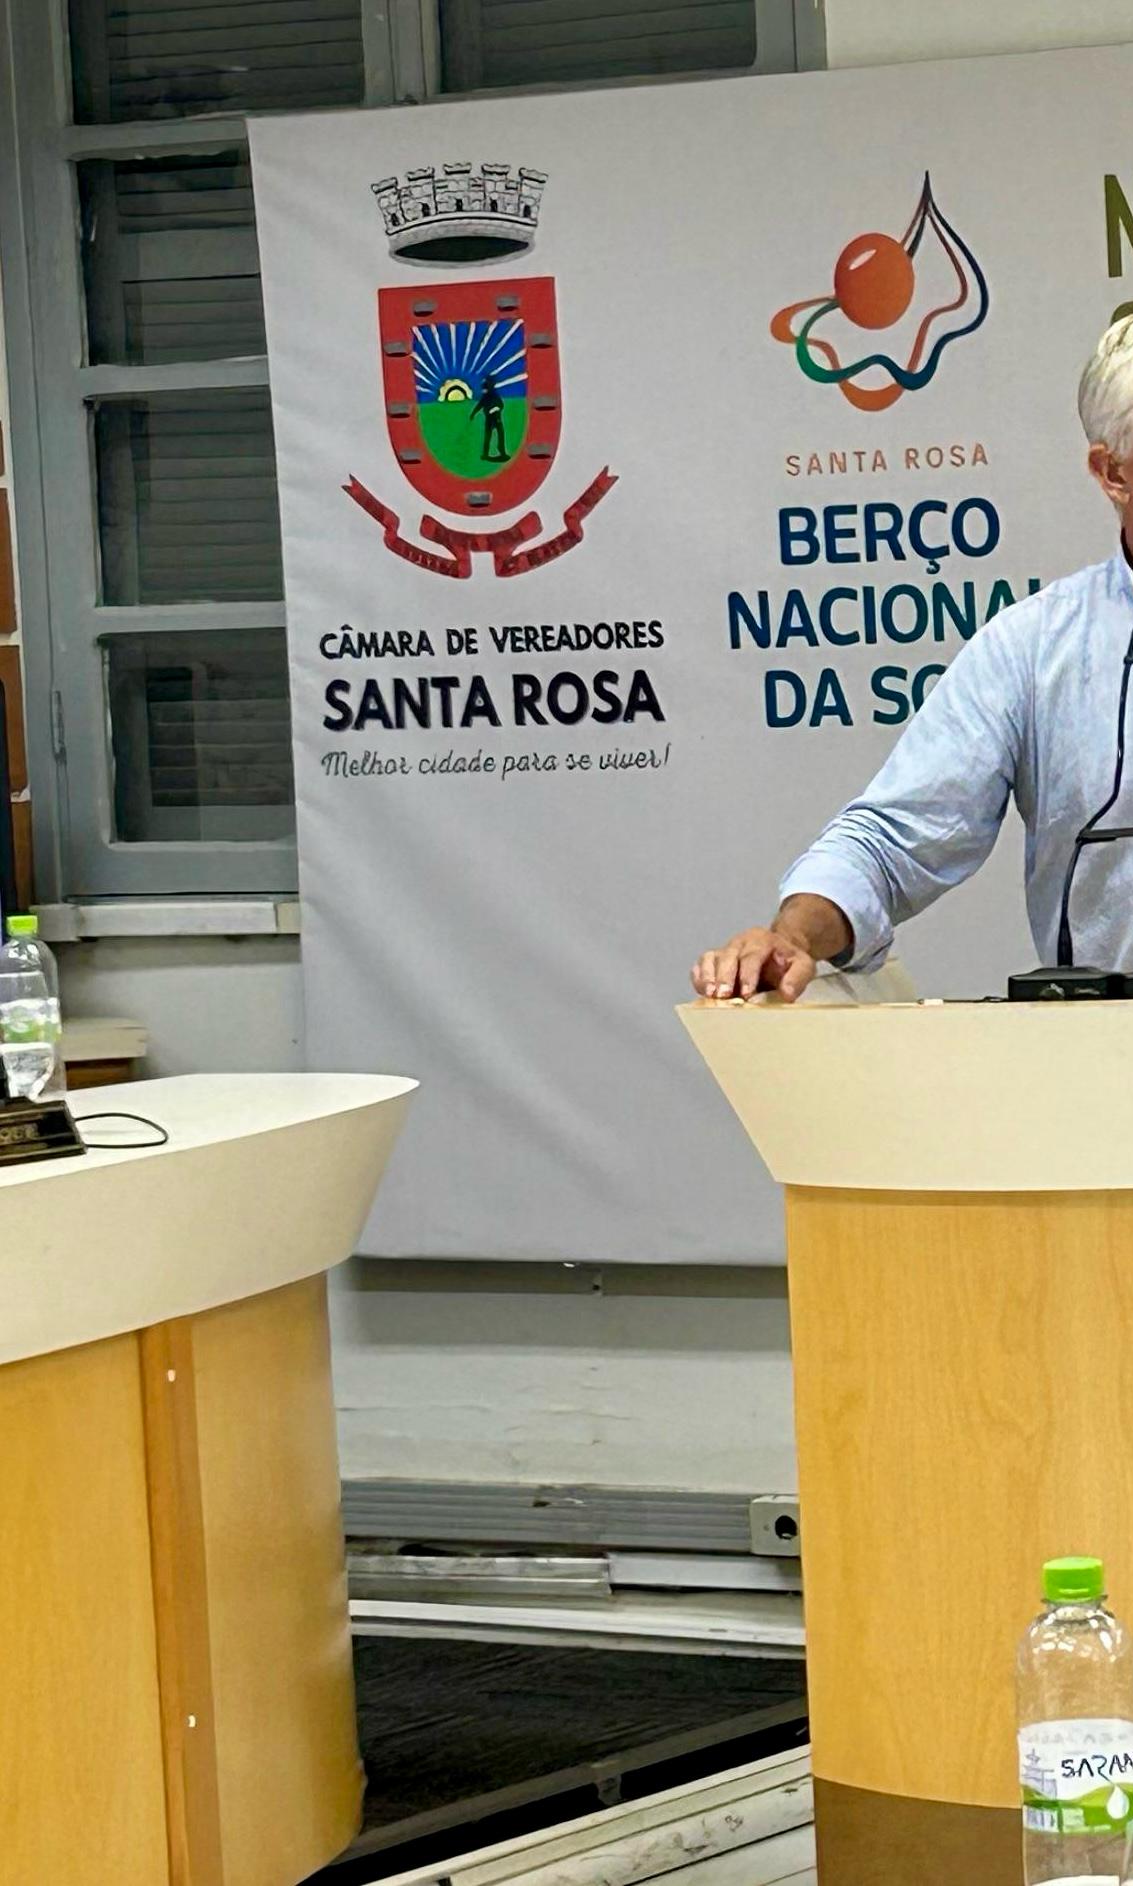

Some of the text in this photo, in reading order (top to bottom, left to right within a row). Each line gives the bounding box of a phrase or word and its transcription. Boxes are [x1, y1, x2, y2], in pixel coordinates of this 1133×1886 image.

[786, 443, 989, 476] SANTA ROSA
[778, 497, 1001, 575] BERÇO
[319, 620, 665, 659] CÂMARA DE VEREADORES
[727, 577, 1041, 650] NACION
[322, 669, 666, 732] SANTA ROSA
[764, 667, 854, 728] DA
[321, 743, 672, 780] Melhor cidade para se viver!
